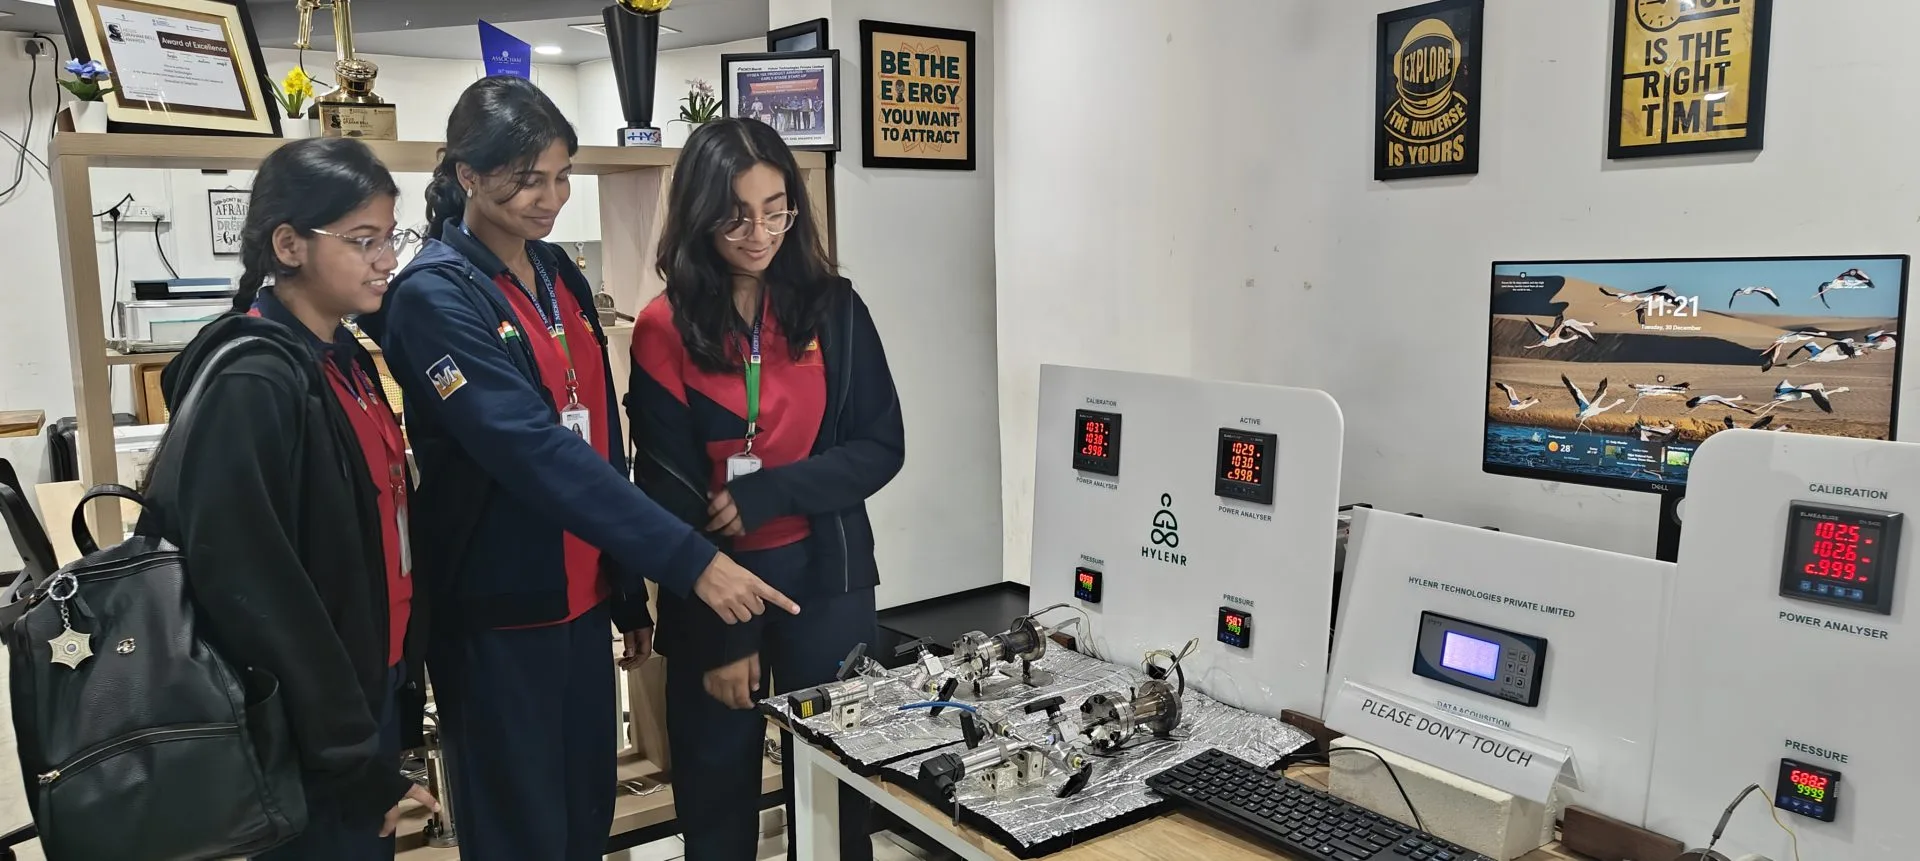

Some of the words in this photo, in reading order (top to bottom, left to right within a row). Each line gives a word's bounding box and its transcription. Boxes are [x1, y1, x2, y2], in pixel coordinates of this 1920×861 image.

[162, 37, 183, 47] Award
[185, 40, 192, 48] of
[193, 41, 228, 53] Excellence
[1645, 38, 1668, 66] IS
[1678, 28, 1732, 61] THE
[881, 50, 910, 75] BE
[915, 54, 959, 79] THE
[1404, 46, 1451, 83] EXPLORE
[1643, 61, 1731, 99] RIGHT
[881, 108, 913, 124] YOU
[916, 110, 959, 127] WANT
[1390, 110, 1409, 133] THE
[1411, 103, 1466, 136] UNIVERSE
[1642, 99, 1728, 137] TIME
[881, 128, 899, 142] TO
[902, 129, 959, 143] ATTRACT
[1388, 141, 1404, 167] IS
[1408, 134, 1464, 164] YOURS
[552, 298, 561, 320] MERU
[1644, 295, 1698, 317] 11:21
[435, 365, 458, 390] M
[1086, 397, 1117, 406] CALIBRATION
[1077, 477, 1092, 485] POWER
[1094, 480, 1118, 490] ANALYSER
[1809, 484, 1888, 500] CALIBRATION
[1219, 506, 1239, 515] POWER
[1241, 510, 1272, 522] ANALYSER
[1081, 554, 1104, 565] PRESSURE
[1142, 547, 1187, 566] HYLENR
[1224, 594, 1254, 607] PRESSURE
[1408, 576, 1438, 589] HYLENR
[1441, 583, 1502, 602] TECHNOLOGIES
[1504, 597, 1538, 611] PRIVATE
[1541, 605, 1575, 618] LIMITED
[1779, 611, 1821, 627] POWER
[1824, 620, 1888, 639] ANALYSER
[1362, 699, 1416, 727] PLEASE
[1416, 717, 1470, 744] DON'T
[1472, 736, 1533, 767] TOUCH
[1785, 739, 1848, 763] PRESSURE
